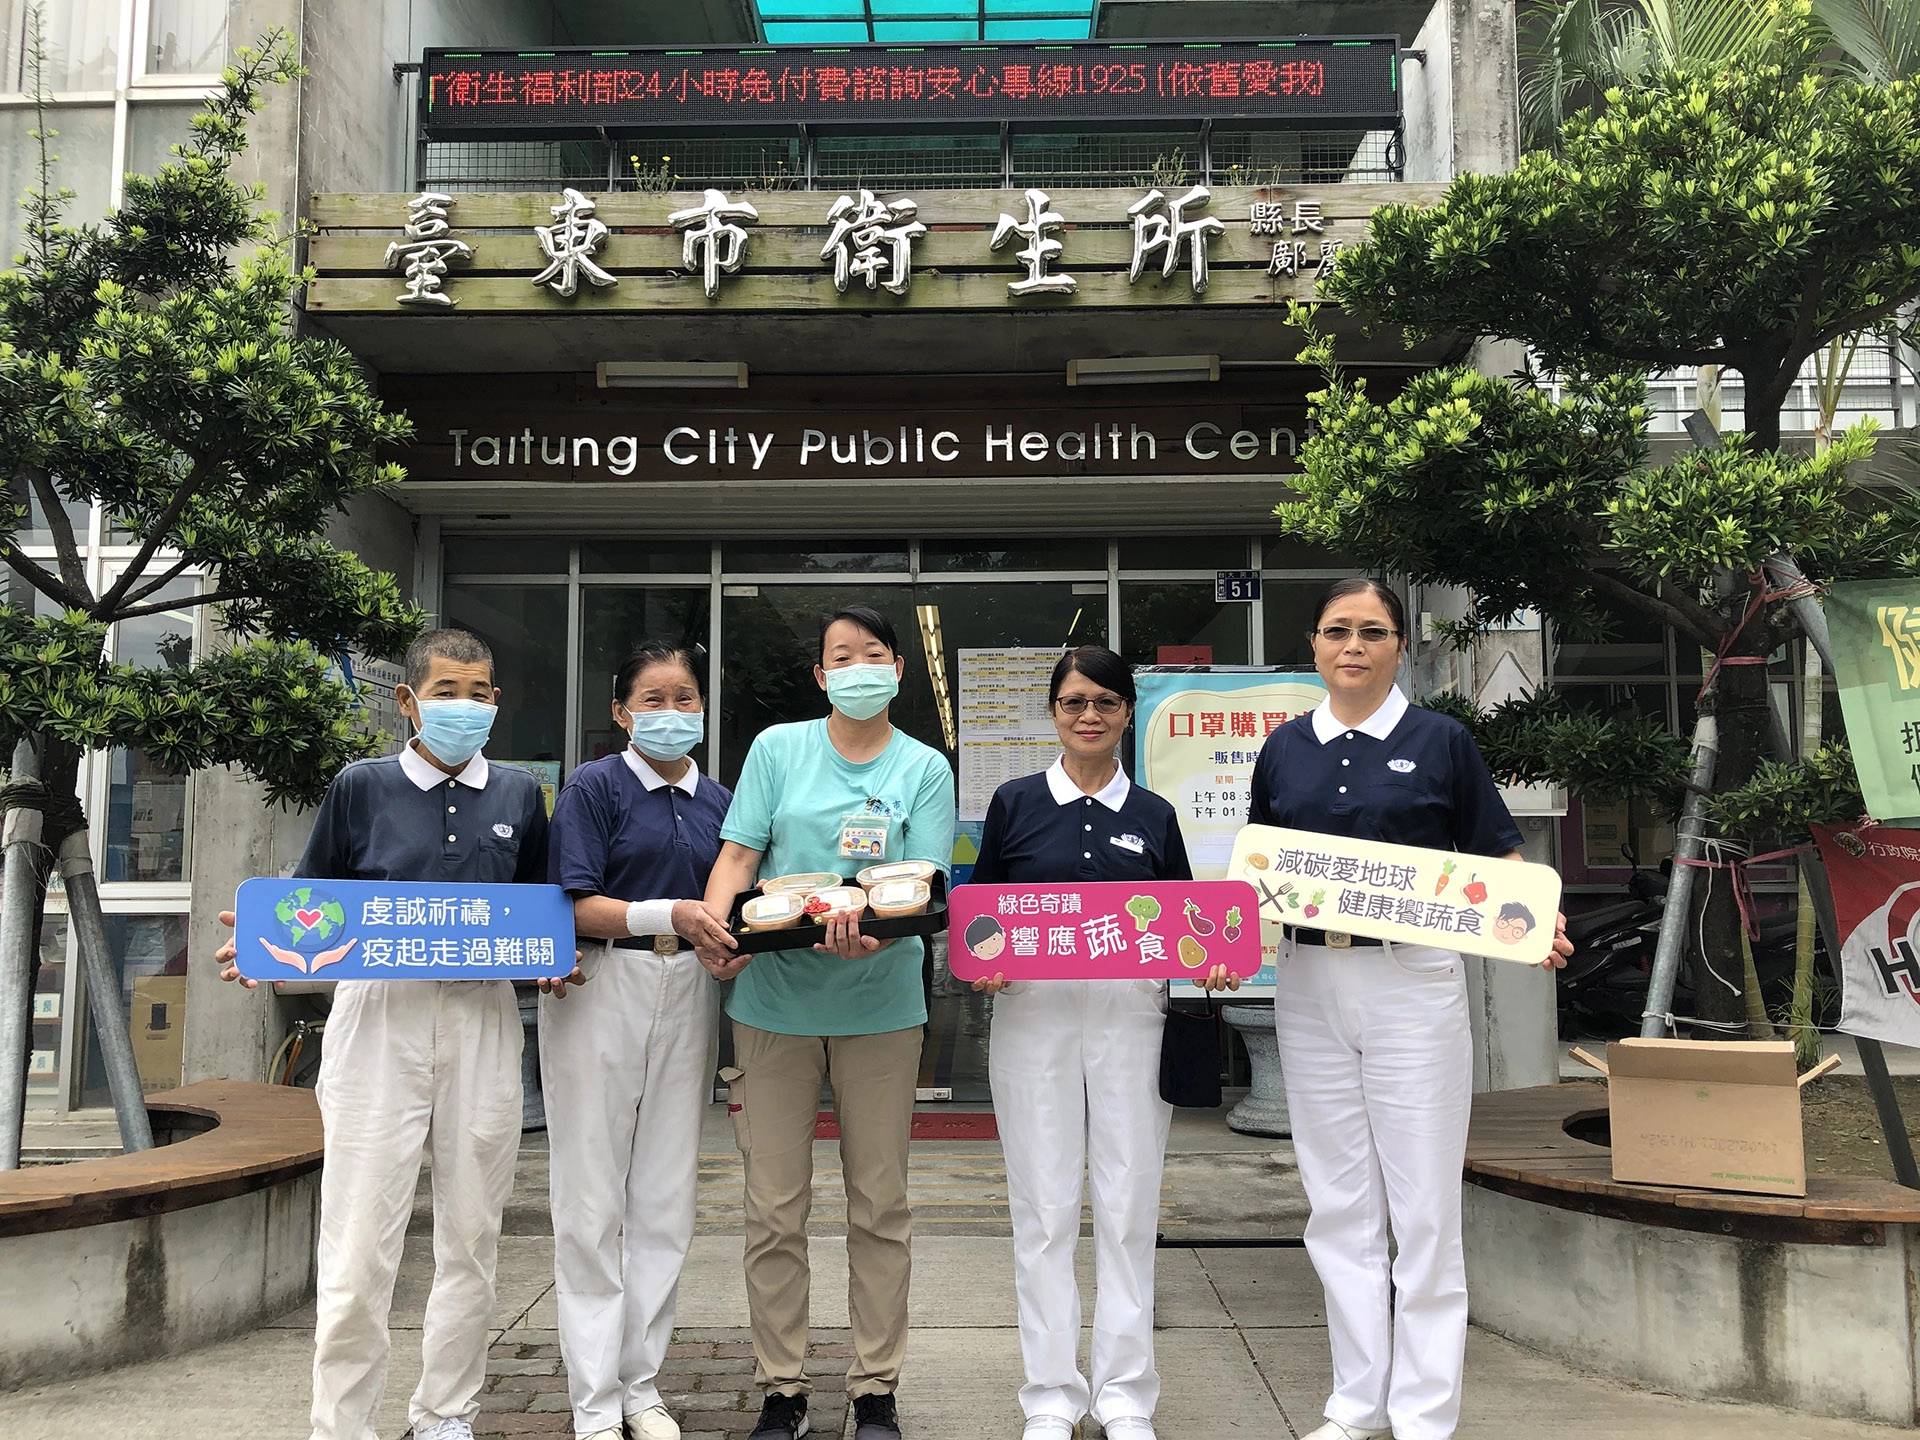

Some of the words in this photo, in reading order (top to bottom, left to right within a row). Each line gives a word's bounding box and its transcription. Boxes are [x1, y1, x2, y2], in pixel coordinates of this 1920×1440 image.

[1250, 202, 1325, 235] 縣長
[383, 185, 1226, 307] 臺東市衛生所
[449, 427, 638, 476] Taitung
[663, 426, 775, 470] City
[800, 425, 961, 466] Public
[985, 422, 1157, 462] Health
[1231, 581, 1252, 597] 51
[1169, 711, 1308, 738] 口罩購買
[1191, 791, 1216, 803] 上午
[1191, 806, 1217, 818] 下午
[1868, 841, 1920, 863] 行政院
[1275, 848, 1417, 891] 減碳愛地球
[998, 893, 1082, 915] 綠色奇蹟
[1337, 888, 1485, 937] 健康饗蔬食
[362, 937, 555, 967] 疫起走過難關
[1011, 914, 1169, 964] 響應蔬食
